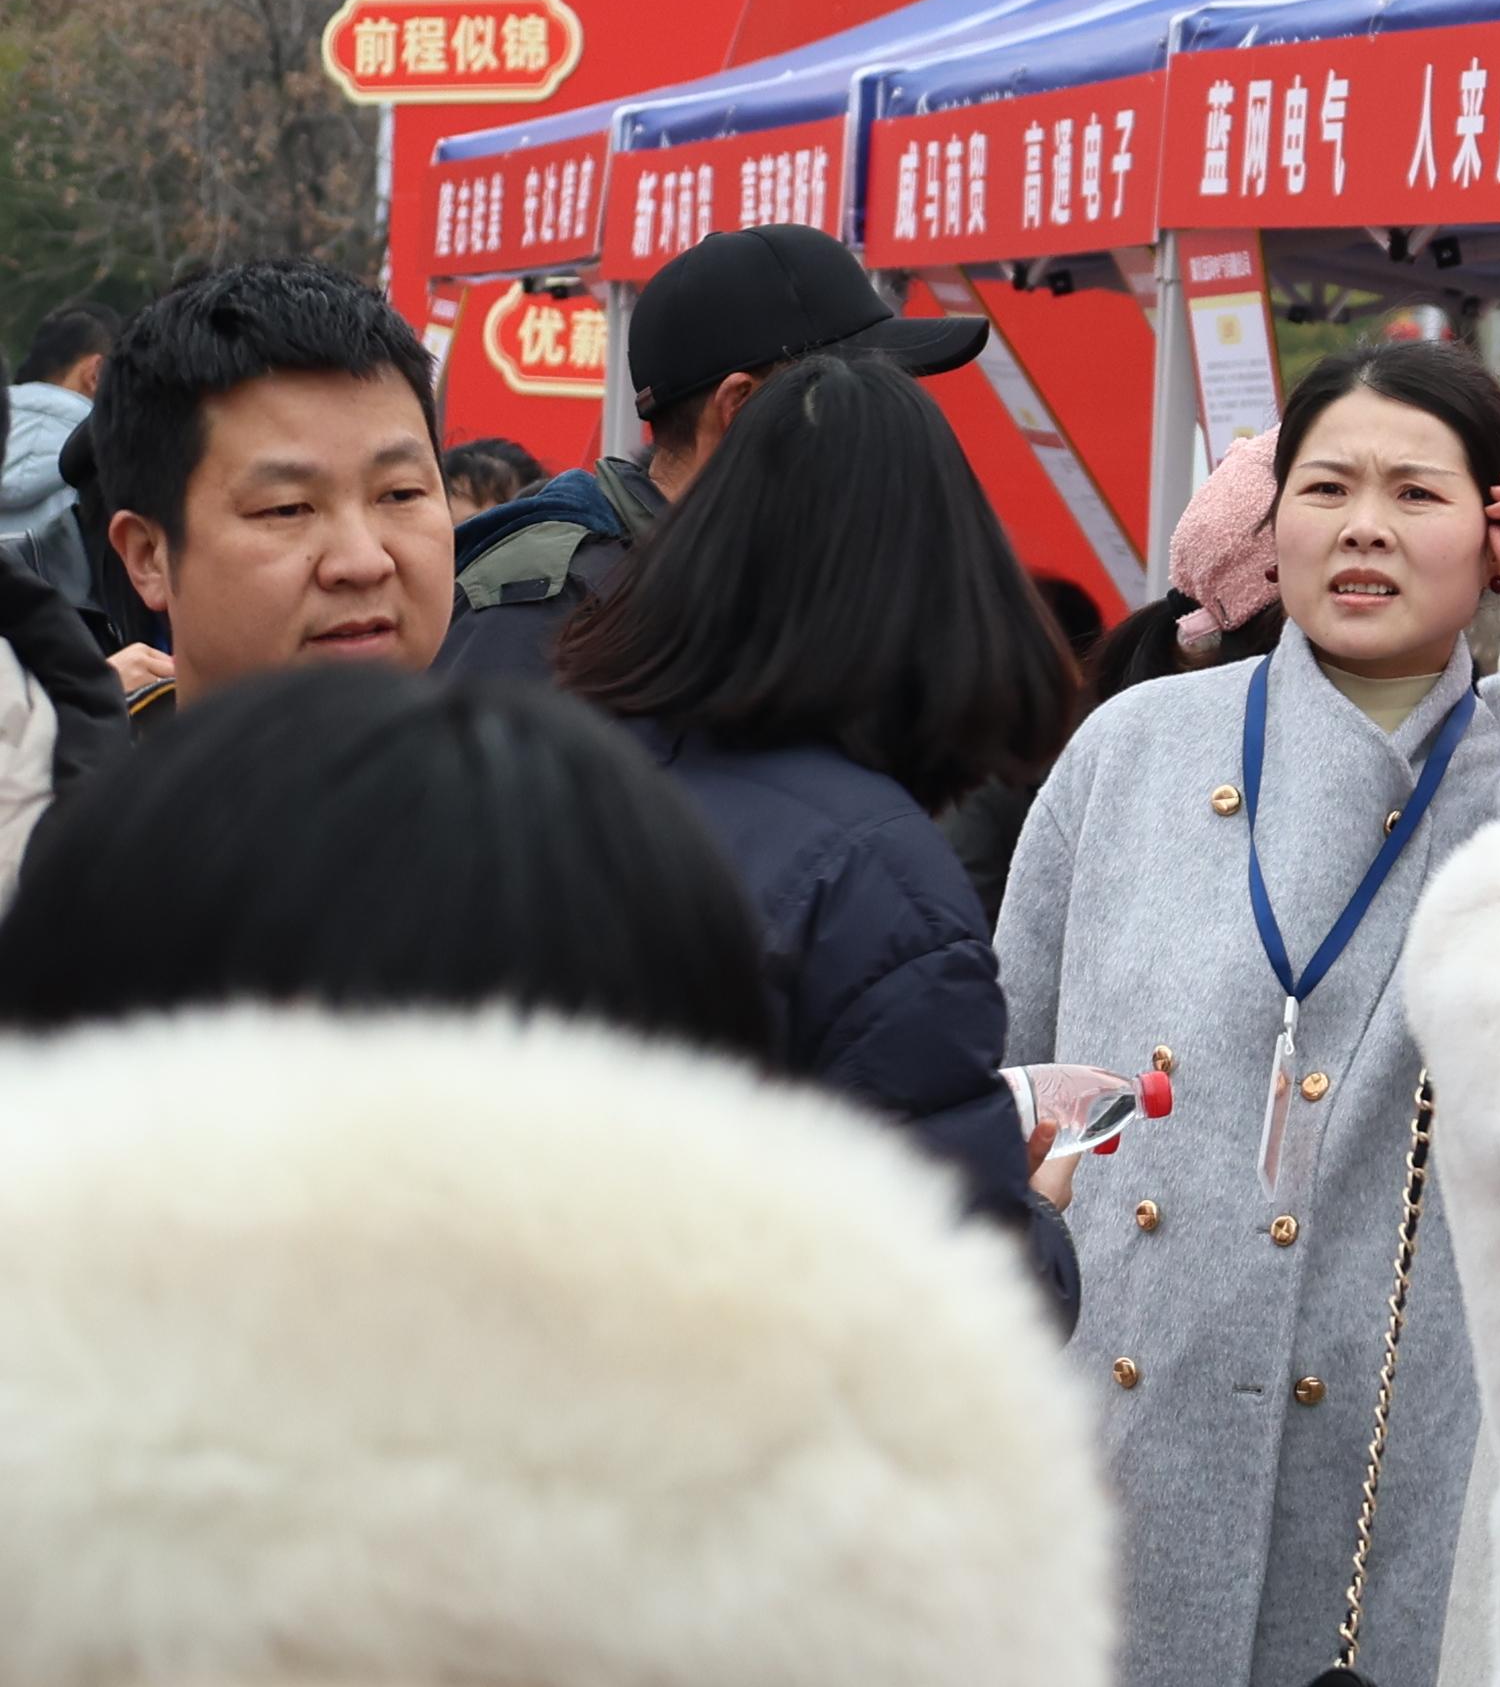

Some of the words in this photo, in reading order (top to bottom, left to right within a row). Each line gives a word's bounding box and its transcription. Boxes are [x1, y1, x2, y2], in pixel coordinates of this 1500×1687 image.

[353, 13, 549, 76] 前程似锦
[1200, 69, 1350, 197] 蓝网电气
